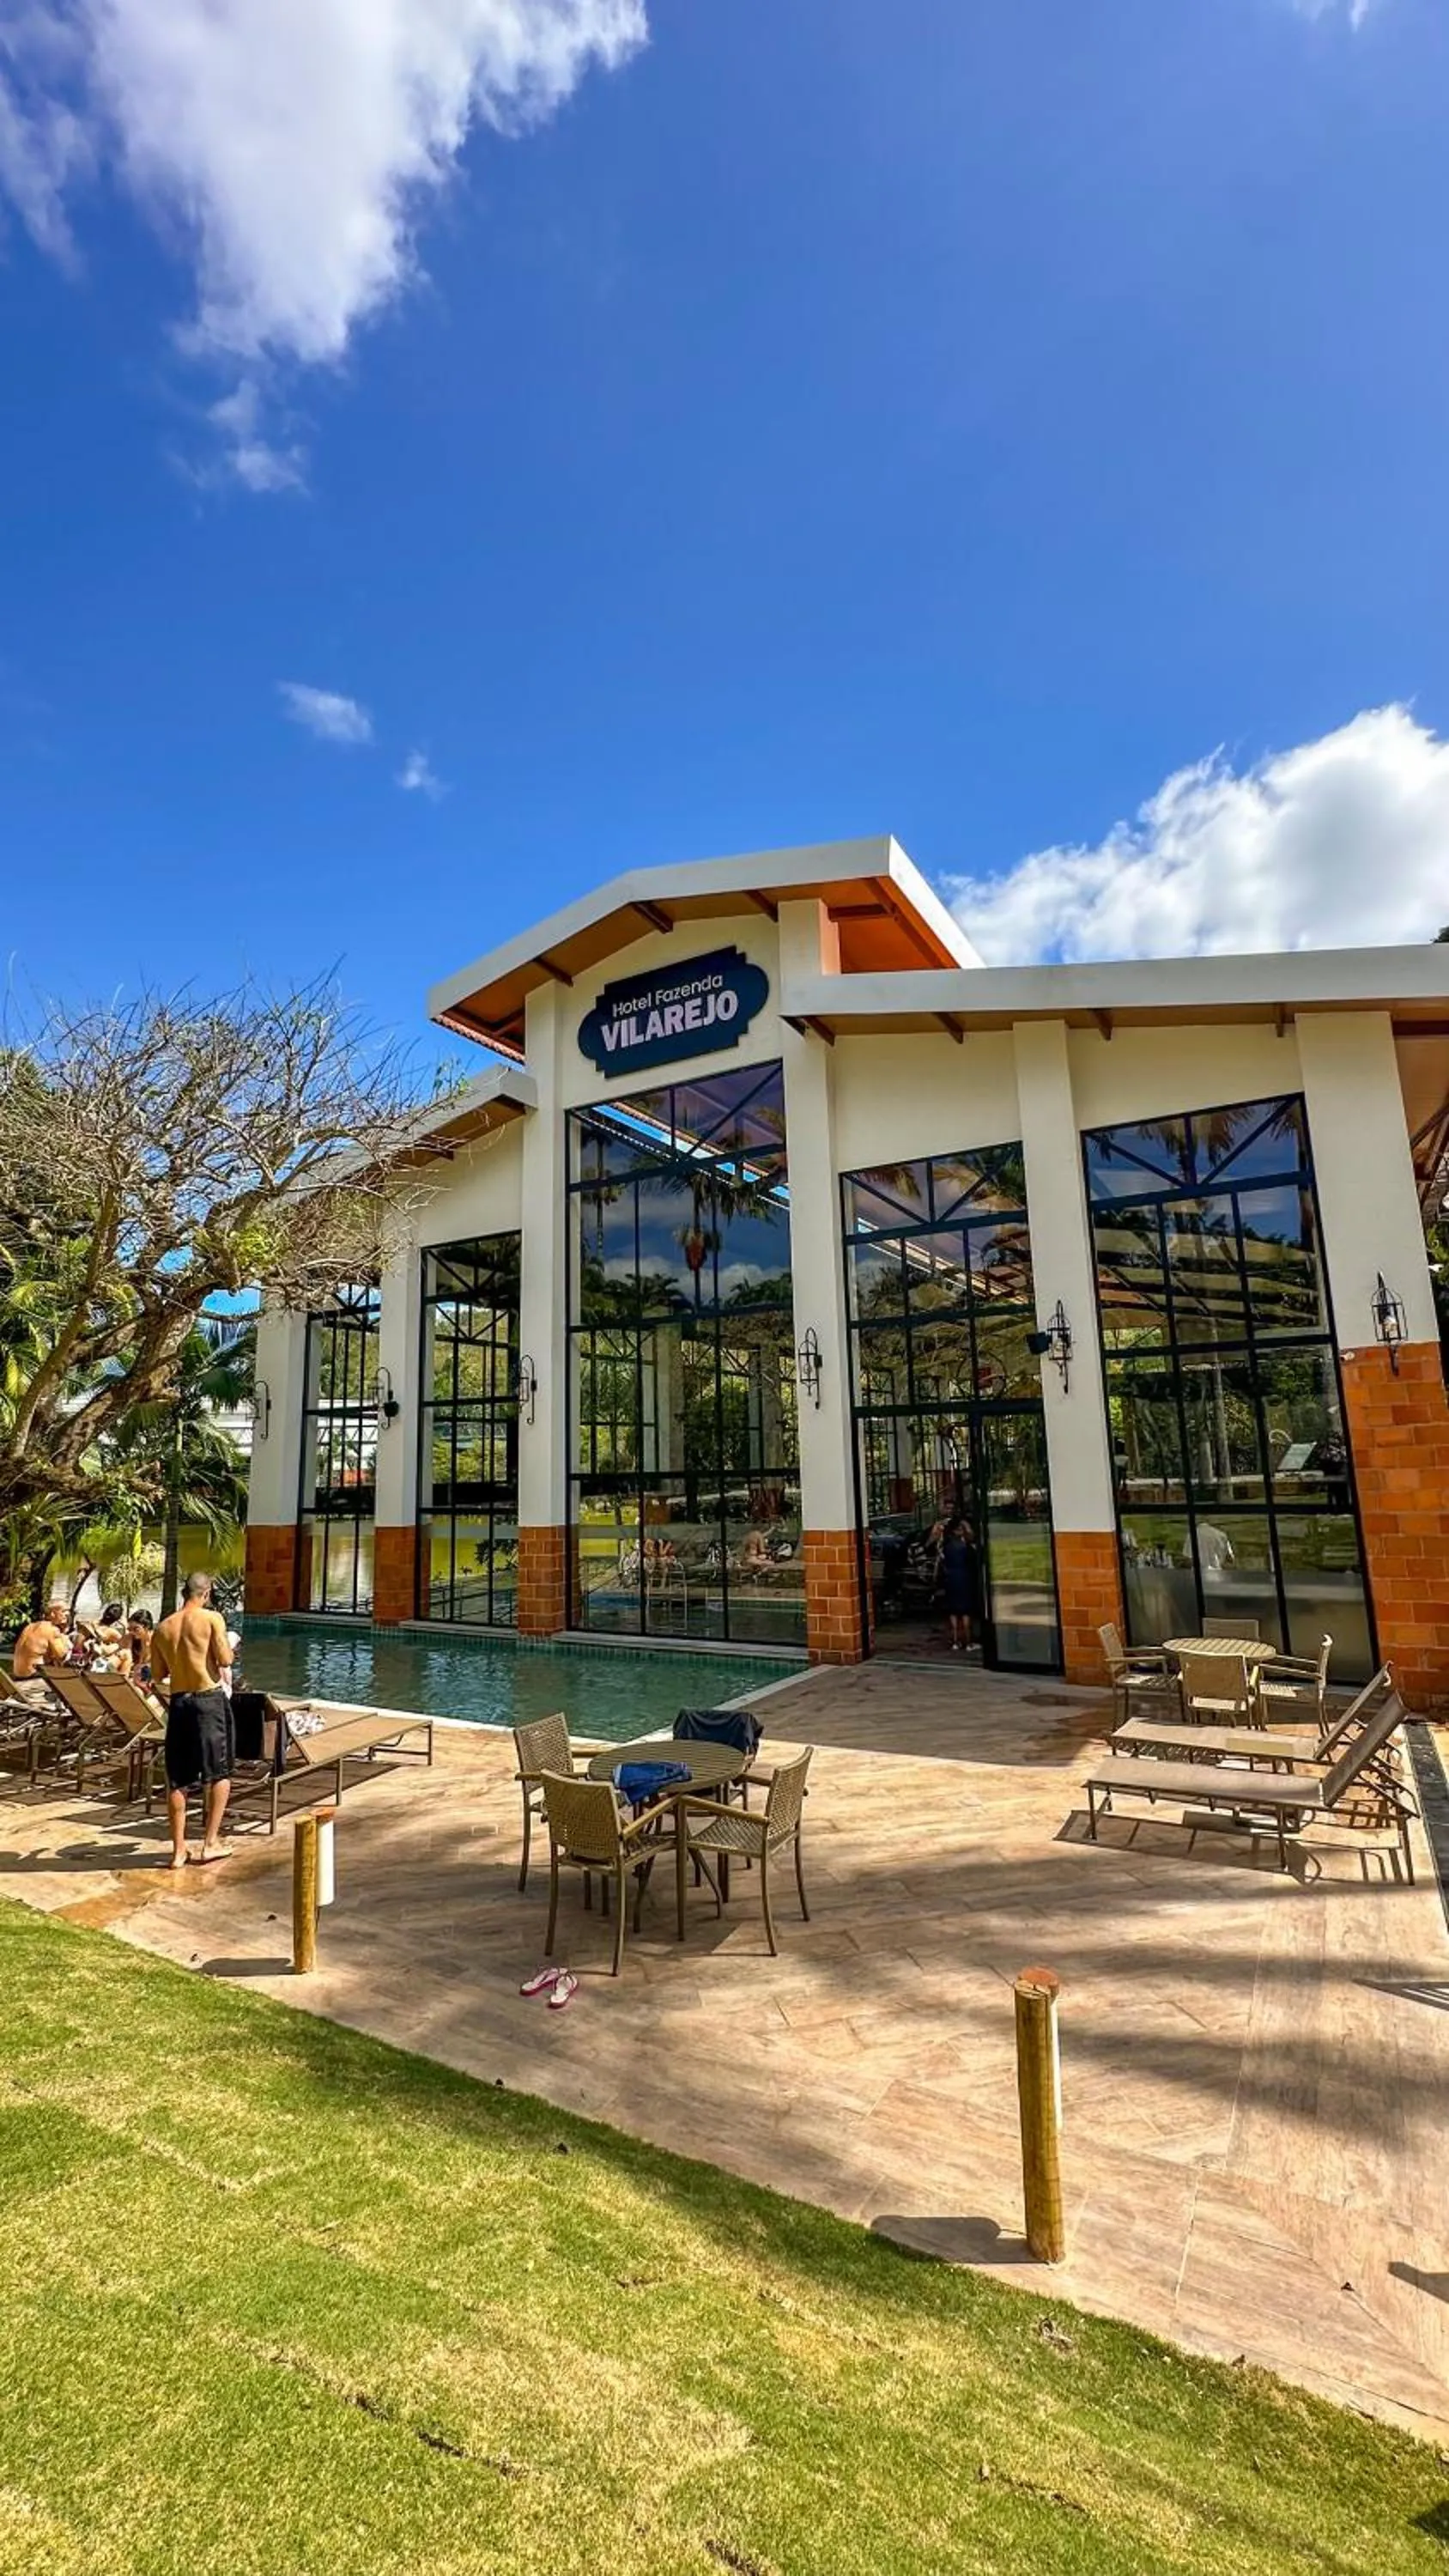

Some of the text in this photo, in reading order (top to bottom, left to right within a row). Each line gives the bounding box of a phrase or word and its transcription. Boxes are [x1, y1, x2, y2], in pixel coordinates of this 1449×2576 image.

[602, 990, 739, 1052] VILAREJO
[612, 975, 723, 1018] Hotel Fazenda
